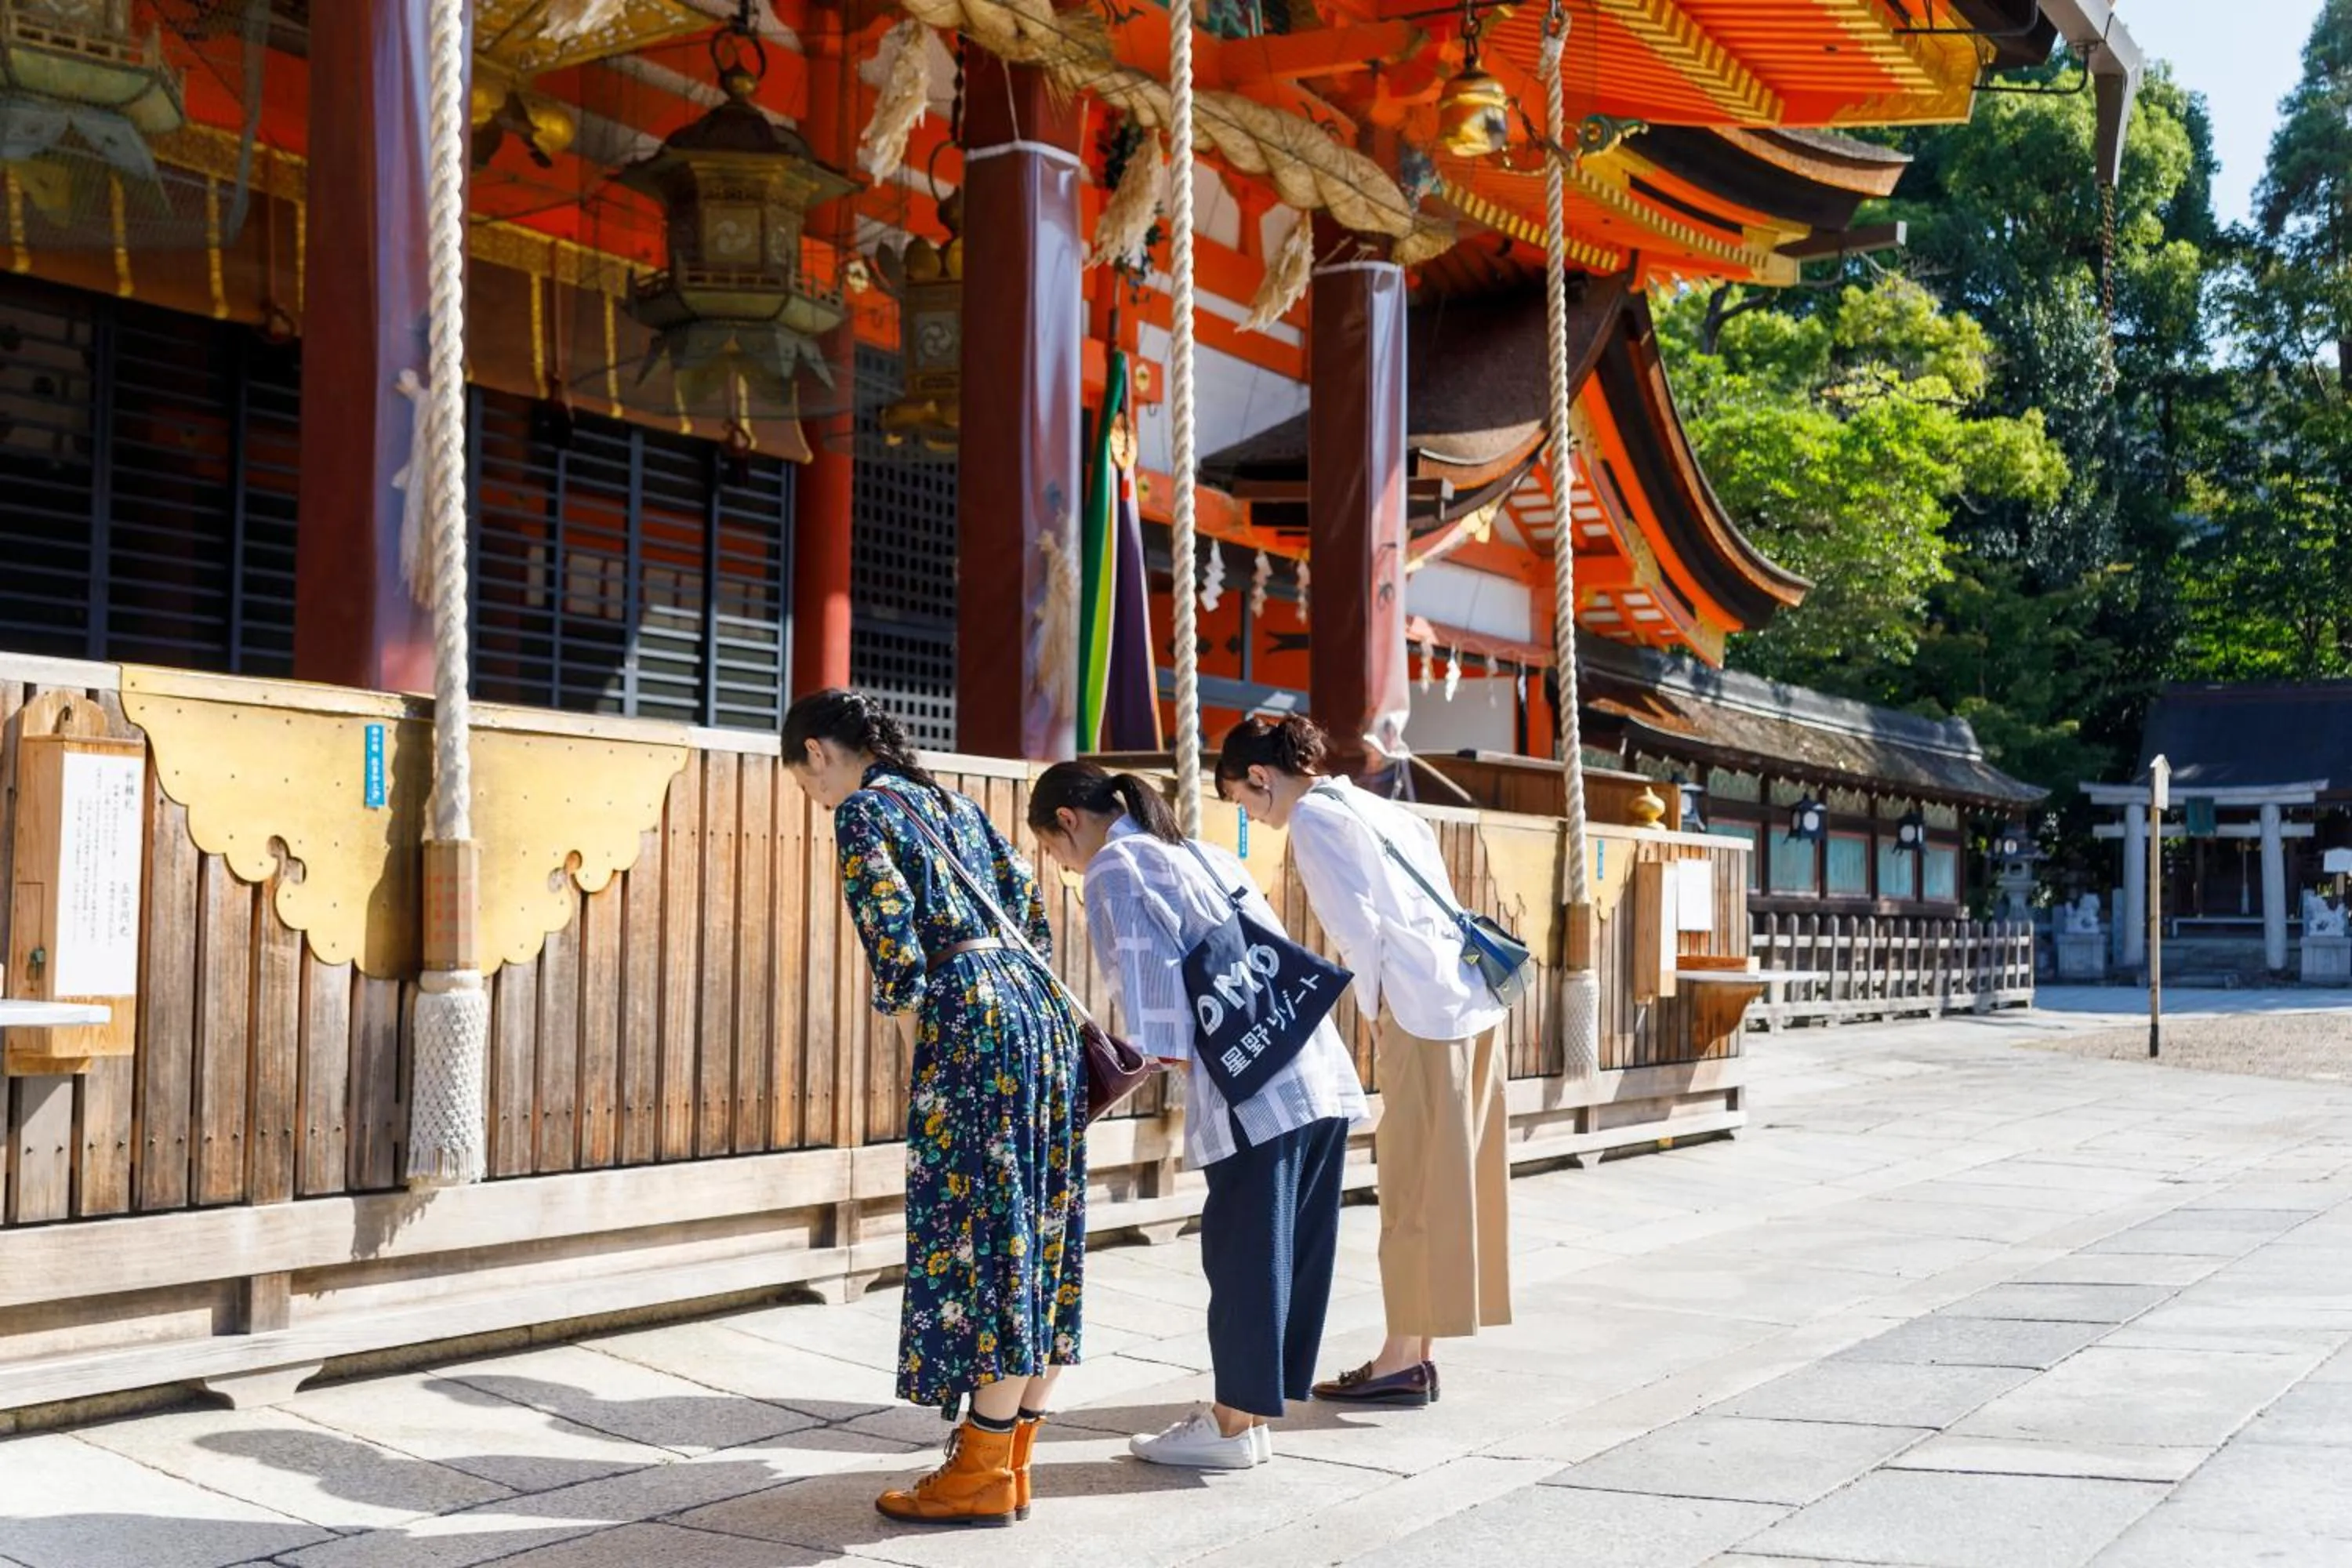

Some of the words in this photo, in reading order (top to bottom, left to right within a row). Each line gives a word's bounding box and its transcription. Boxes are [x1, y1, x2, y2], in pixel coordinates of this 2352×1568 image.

[1220, 974, 1320, 1078] 星野リゾート
